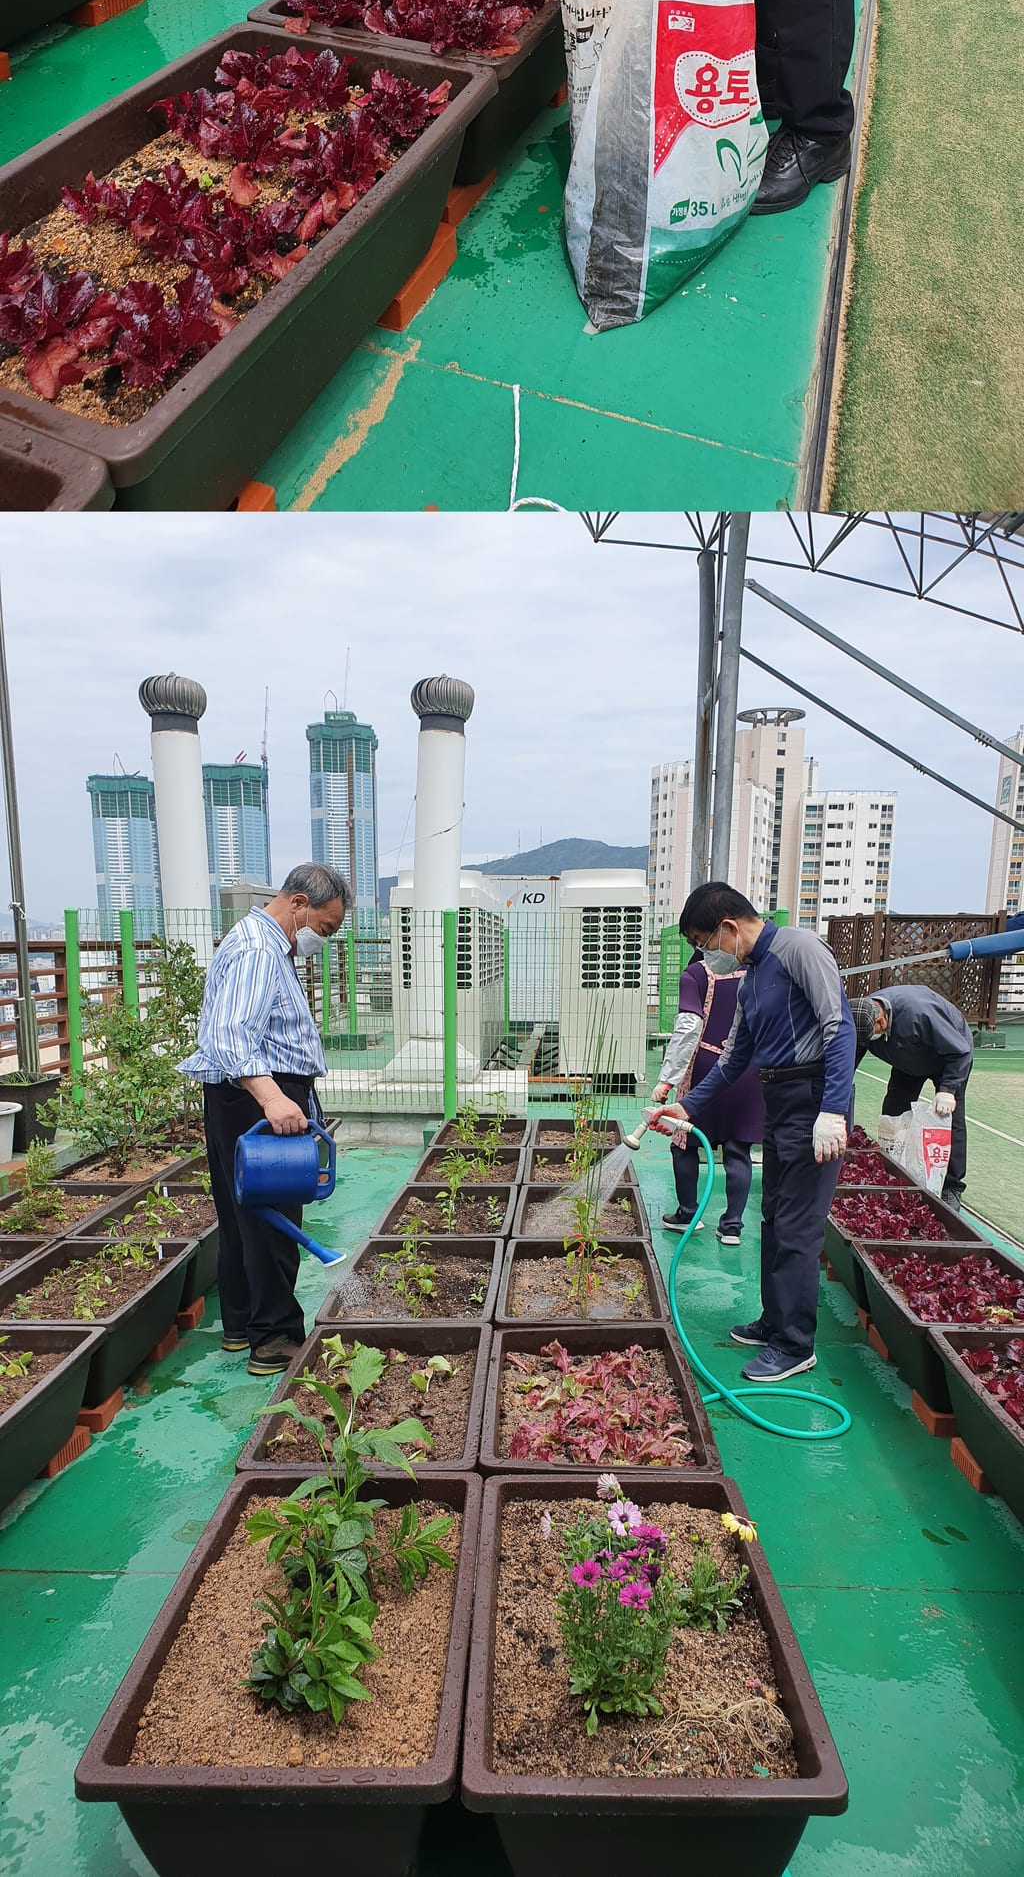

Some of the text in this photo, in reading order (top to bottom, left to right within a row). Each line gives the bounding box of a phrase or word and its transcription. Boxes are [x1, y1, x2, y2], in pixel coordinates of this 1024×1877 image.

[684, 62, 751, 114] 용토
[690, 201, 718, 218] 35 L
[522, 893, 545, 904] KD
[930, 1147, 949, 1163] 용토
